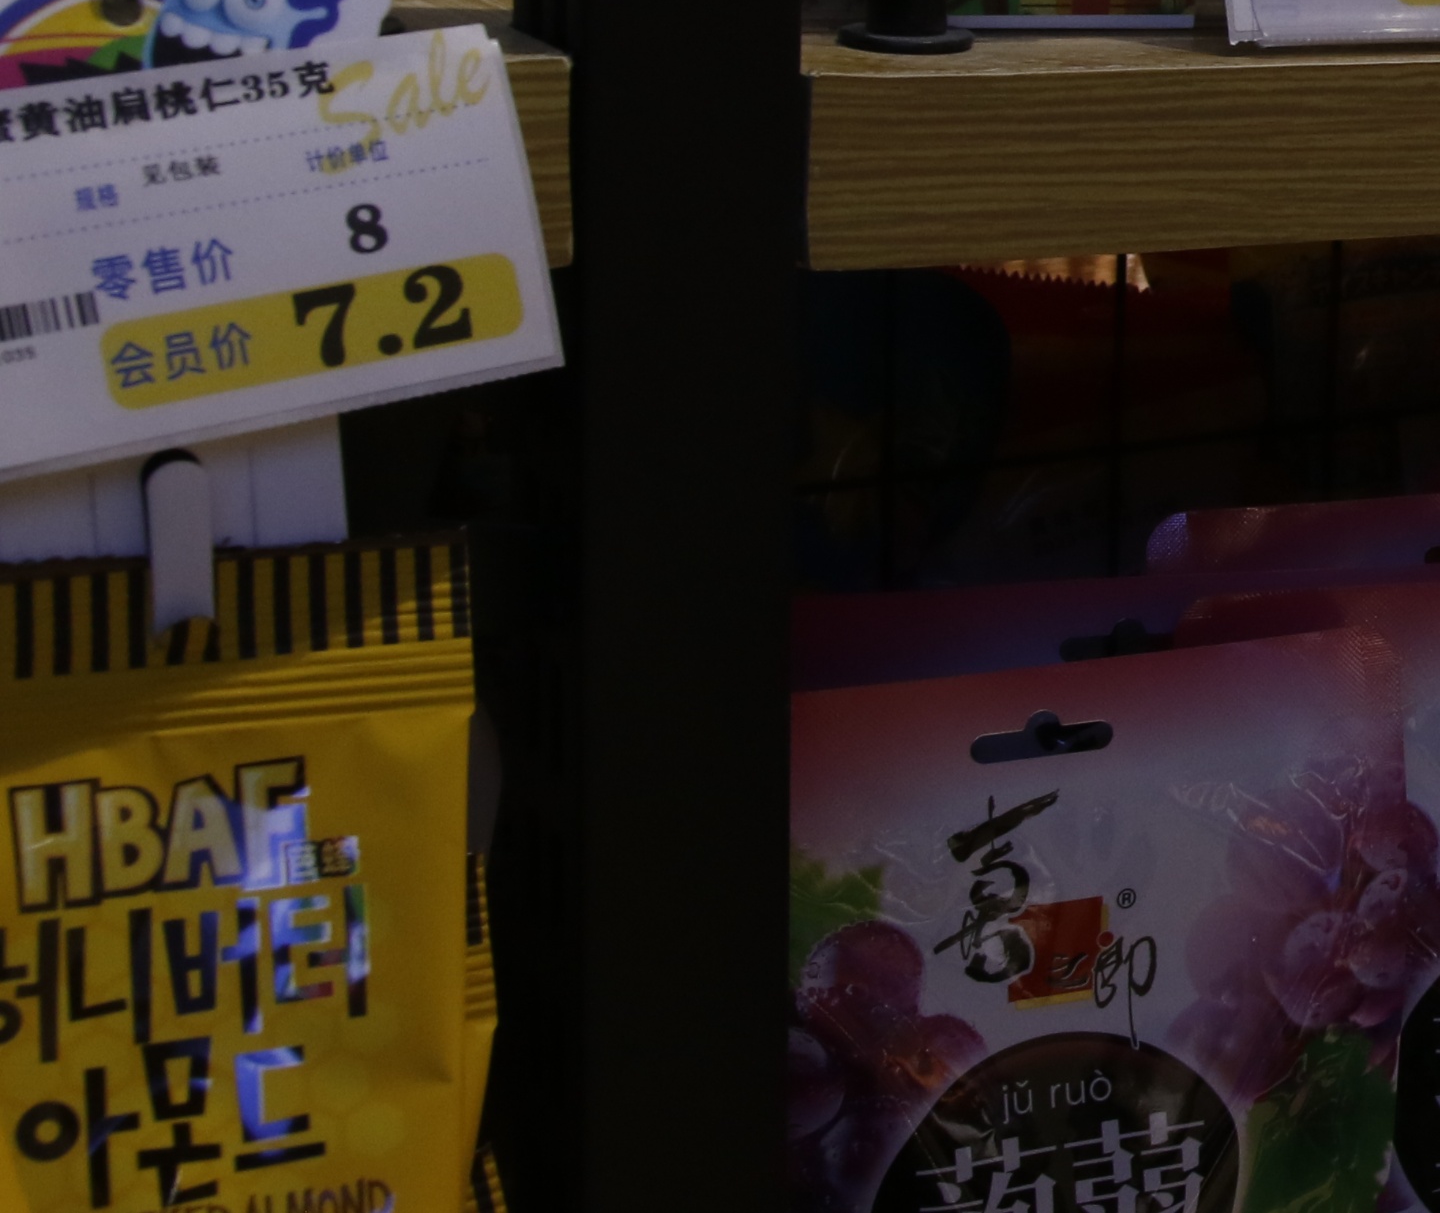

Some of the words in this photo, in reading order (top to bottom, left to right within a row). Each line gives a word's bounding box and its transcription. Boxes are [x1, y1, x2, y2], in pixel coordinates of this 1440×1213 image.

[318, 28, 491, 149] Sale
[141, 155, 222, 187] 见包装
[305, 139, 390, 173] 计价单位
[91, 238, 234, 301] 零售价
[345, 204, 389, 255] 8
[111, 321, 253, 389] 会员价
[292, 264, 474, 368] 7.2
[10, 755, 310, 914] HBAF
[0, 884, 370, 1063] 허니버터
[16, 1036, 326, 1208] 아몬드
[1048, 1070, 1112, 1107] ruò
